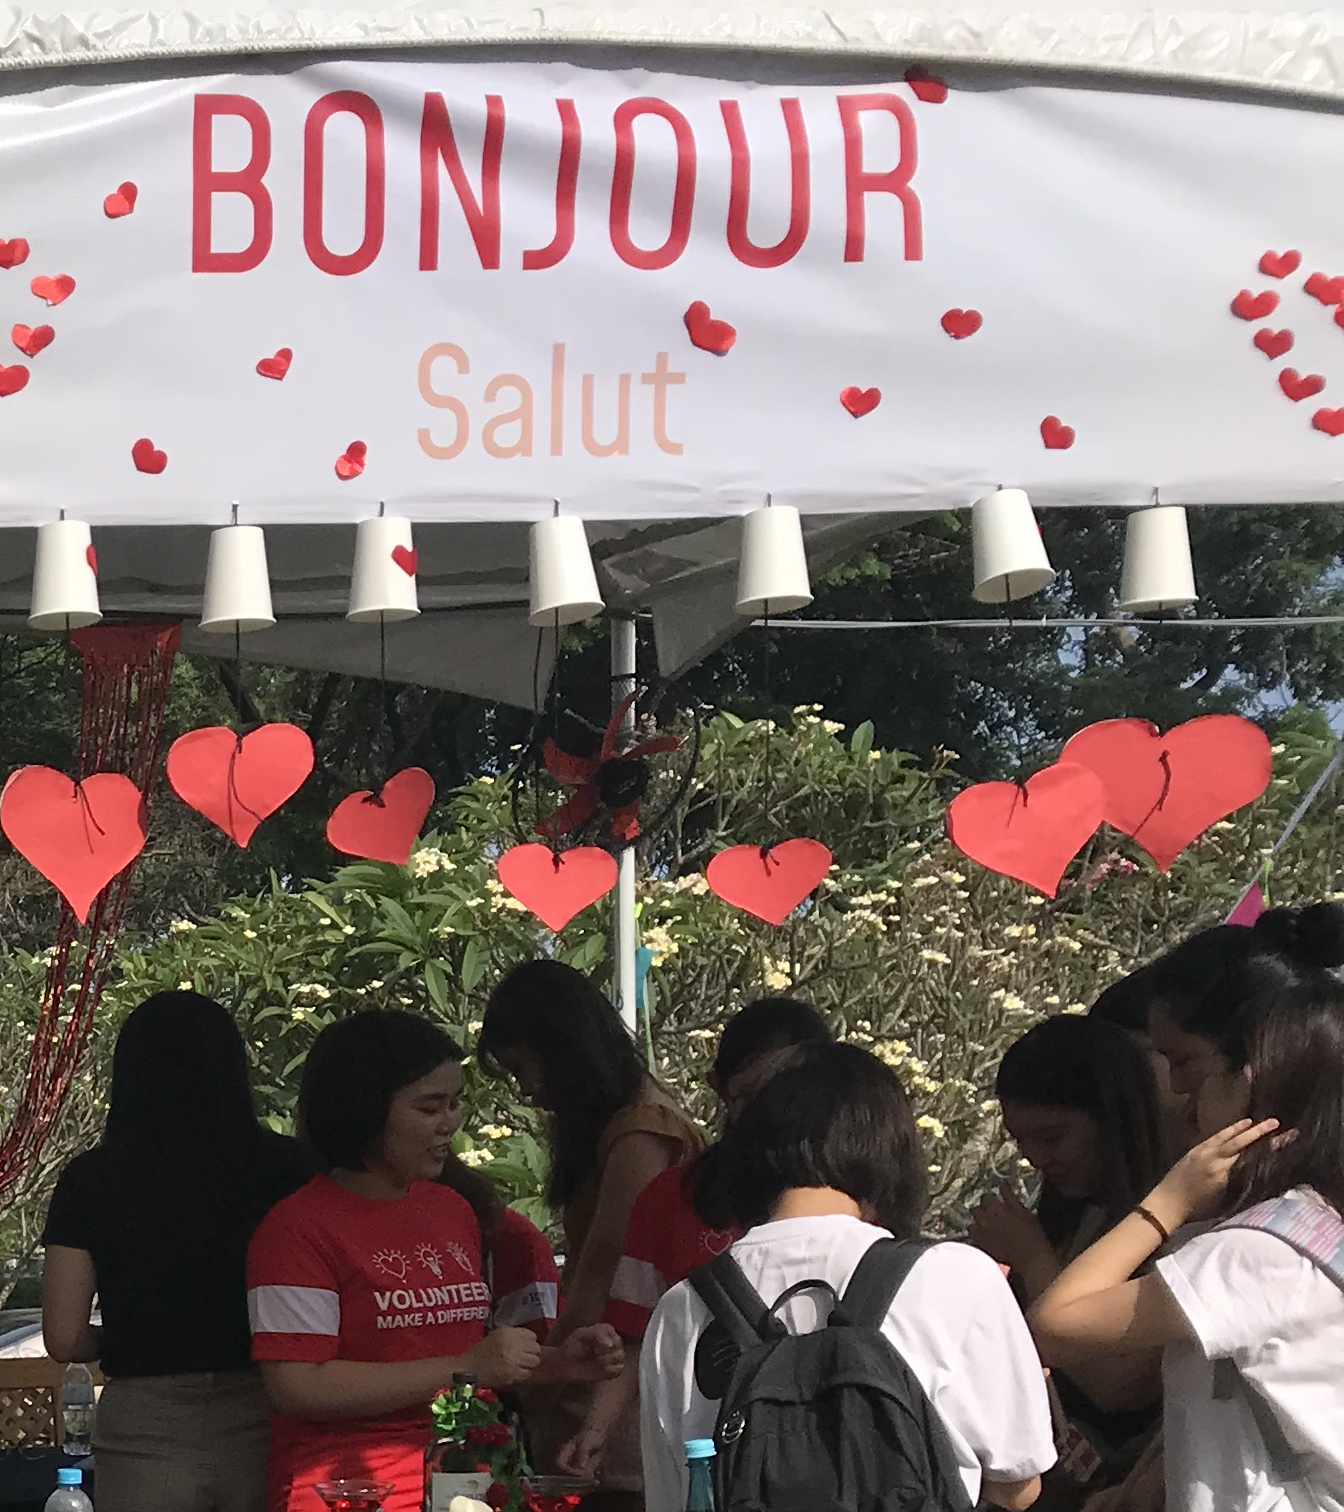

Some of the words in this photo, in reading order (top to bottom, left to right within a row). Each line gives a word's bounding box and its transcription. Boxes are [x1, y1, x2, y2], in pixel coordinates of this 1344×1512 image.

[190, 90, 923, 278] BONJOUR
[418, 343, 685, 459] Salut
[373, 1282, 491, 1311] VOLUNTEER
[377, 1312, 423, 1329] MAKE
[425, 1311, 436, 1325] A
